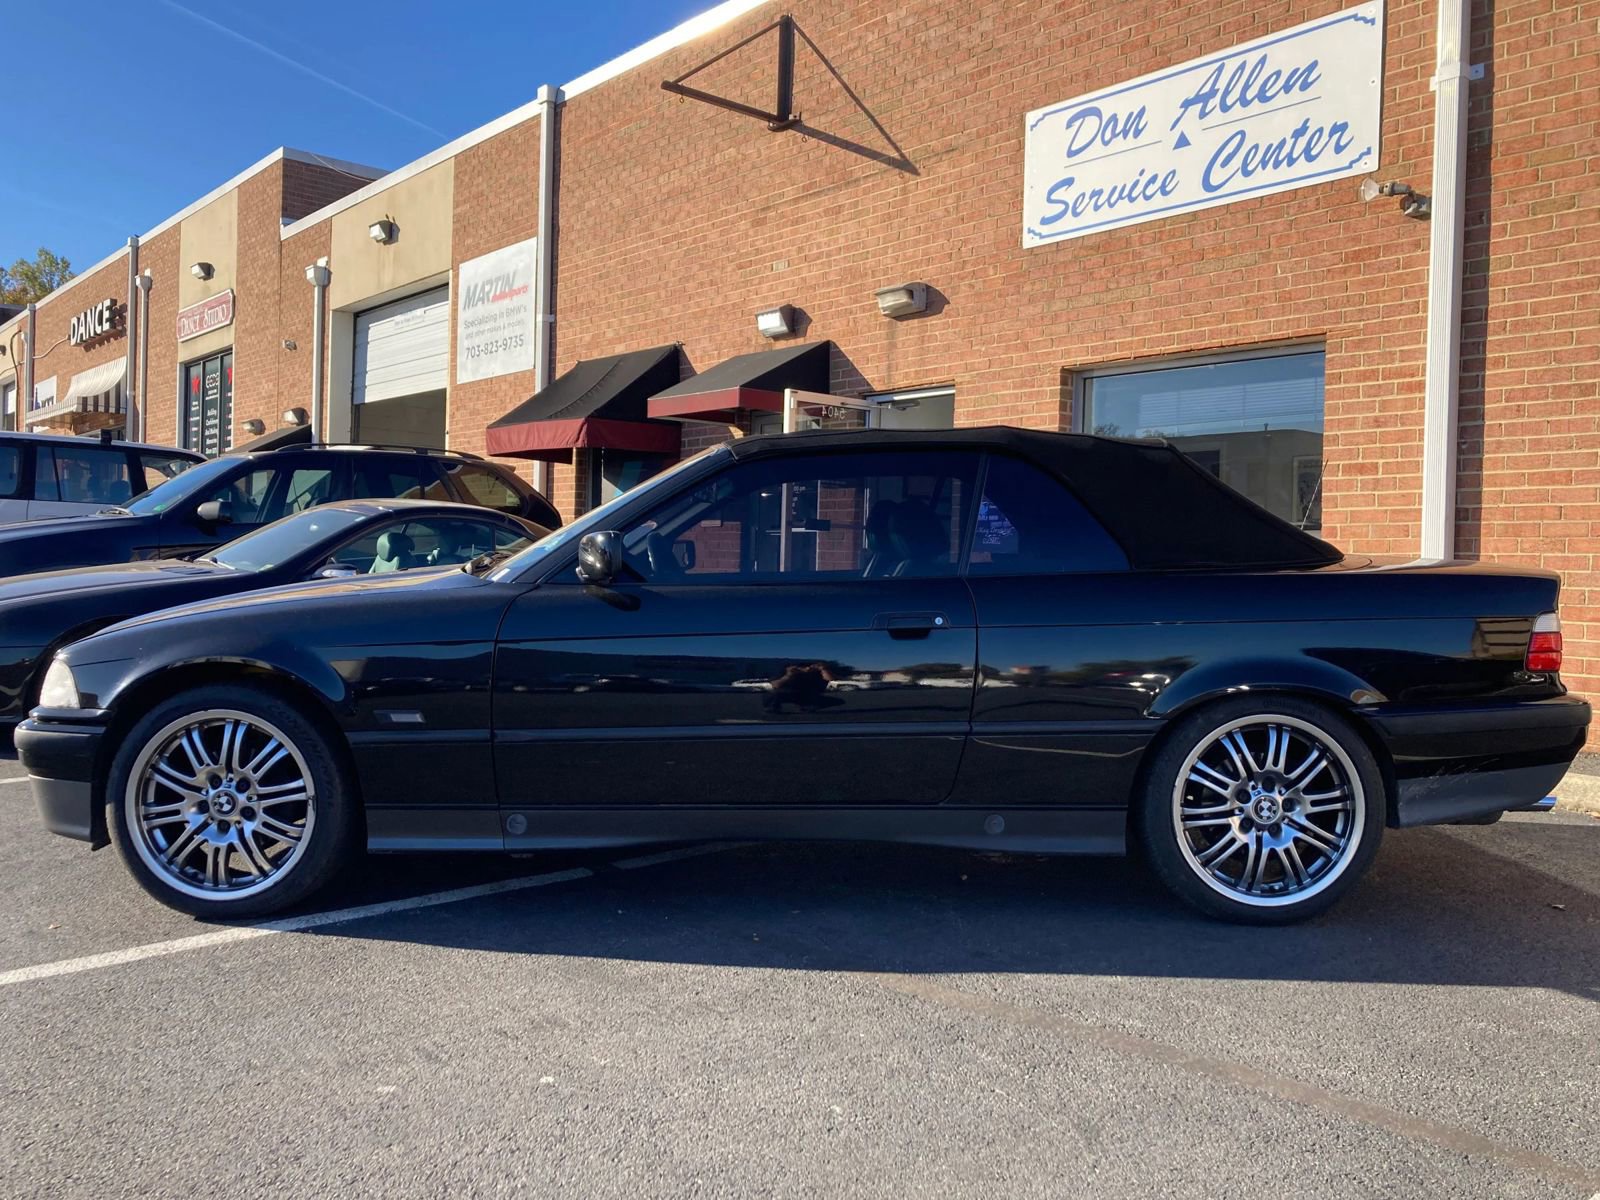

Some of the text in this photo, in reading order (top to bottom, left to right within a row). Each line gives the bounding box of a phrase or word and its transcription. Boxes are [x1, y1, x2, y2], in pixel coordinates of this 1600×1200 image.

[1065, 53, 1322, 159] Don Allen
[1039, 117, 1355, 226] Service Center
[463, 271, 518, 311] MARTIN
[70, 298, 112, 346] DANCE
[463, 310, 498, 330] Specializing
[505, 304, 527, 319] BMW's
[465, 334, 525, 360] 703-823-9735
